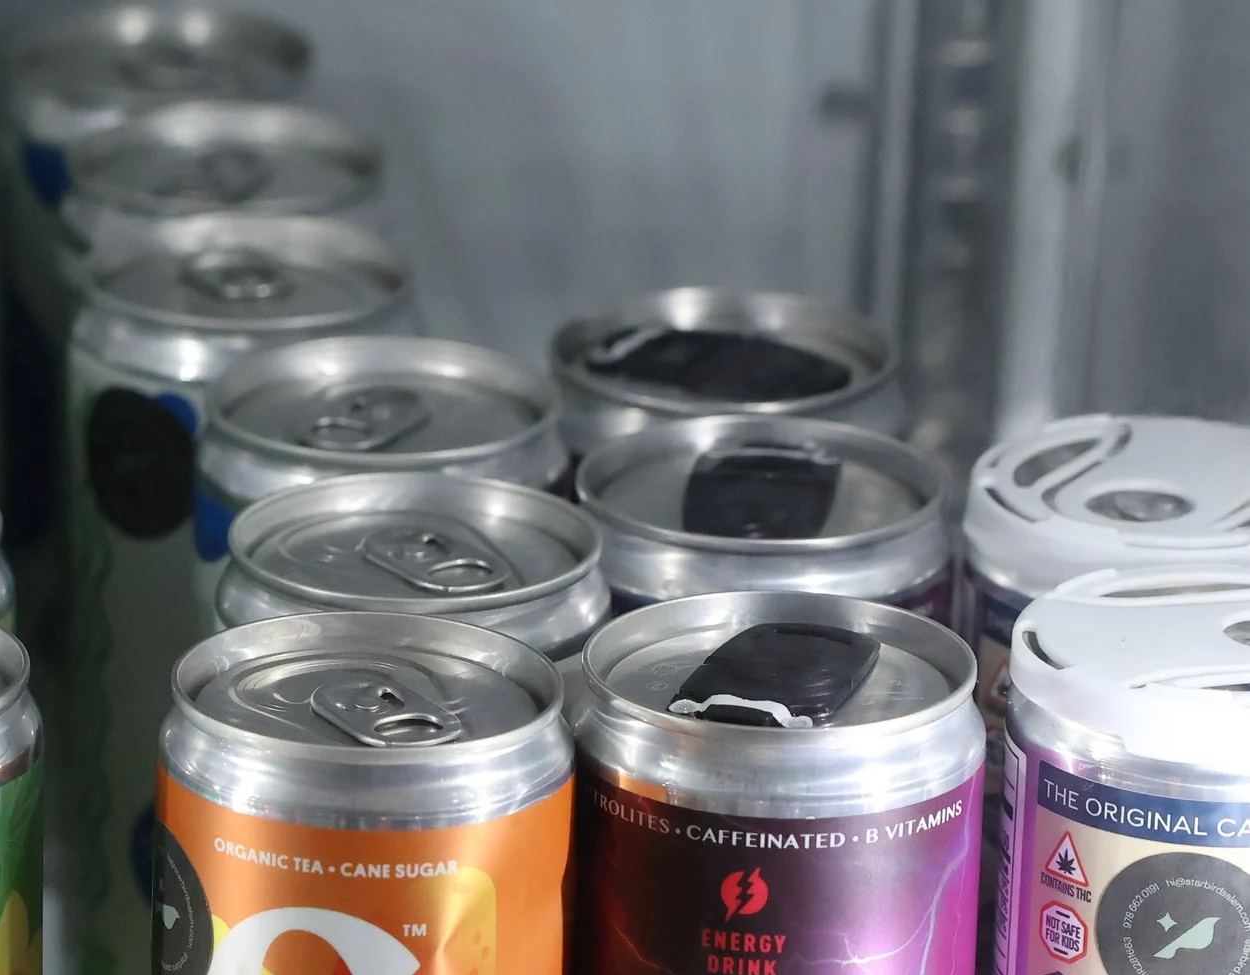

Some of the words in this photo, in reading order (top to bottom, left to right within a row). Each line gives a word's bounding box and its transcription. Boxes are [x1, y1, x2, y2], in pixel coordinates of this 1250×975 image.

[1044, 779, 1079, 810] THE
[1085, 798, 1207, 836] ORIGINAL
[686, 825, 845, 849] CAFFEINATED
[865, 828, 878, 844] B
[885, 800, 963, 840] VITAMINS
[214, 837, 289, 870] ORGANIC
[293, 856, 323, 875] TEA
[340, 862, 390, 878] CANE
[395, 860, 458, 879] SUGAR
[1040, 872, 1074, 897] CONTAINS
[1076, 887, 1091, 903] THC
[1045, 914, 1060, 931] NOT
[1061, 921, 1080, 939] SAFE
[1123, 911, 1134, 929] 978
[1129, 895, 1144, 912] 662
[403, 924, 427, 937] TM
[701, 928, 787, 954] ENERGY
[1045, 928, 1060, 945] FOR
[1061, 934, 1080, 952] KIDS
